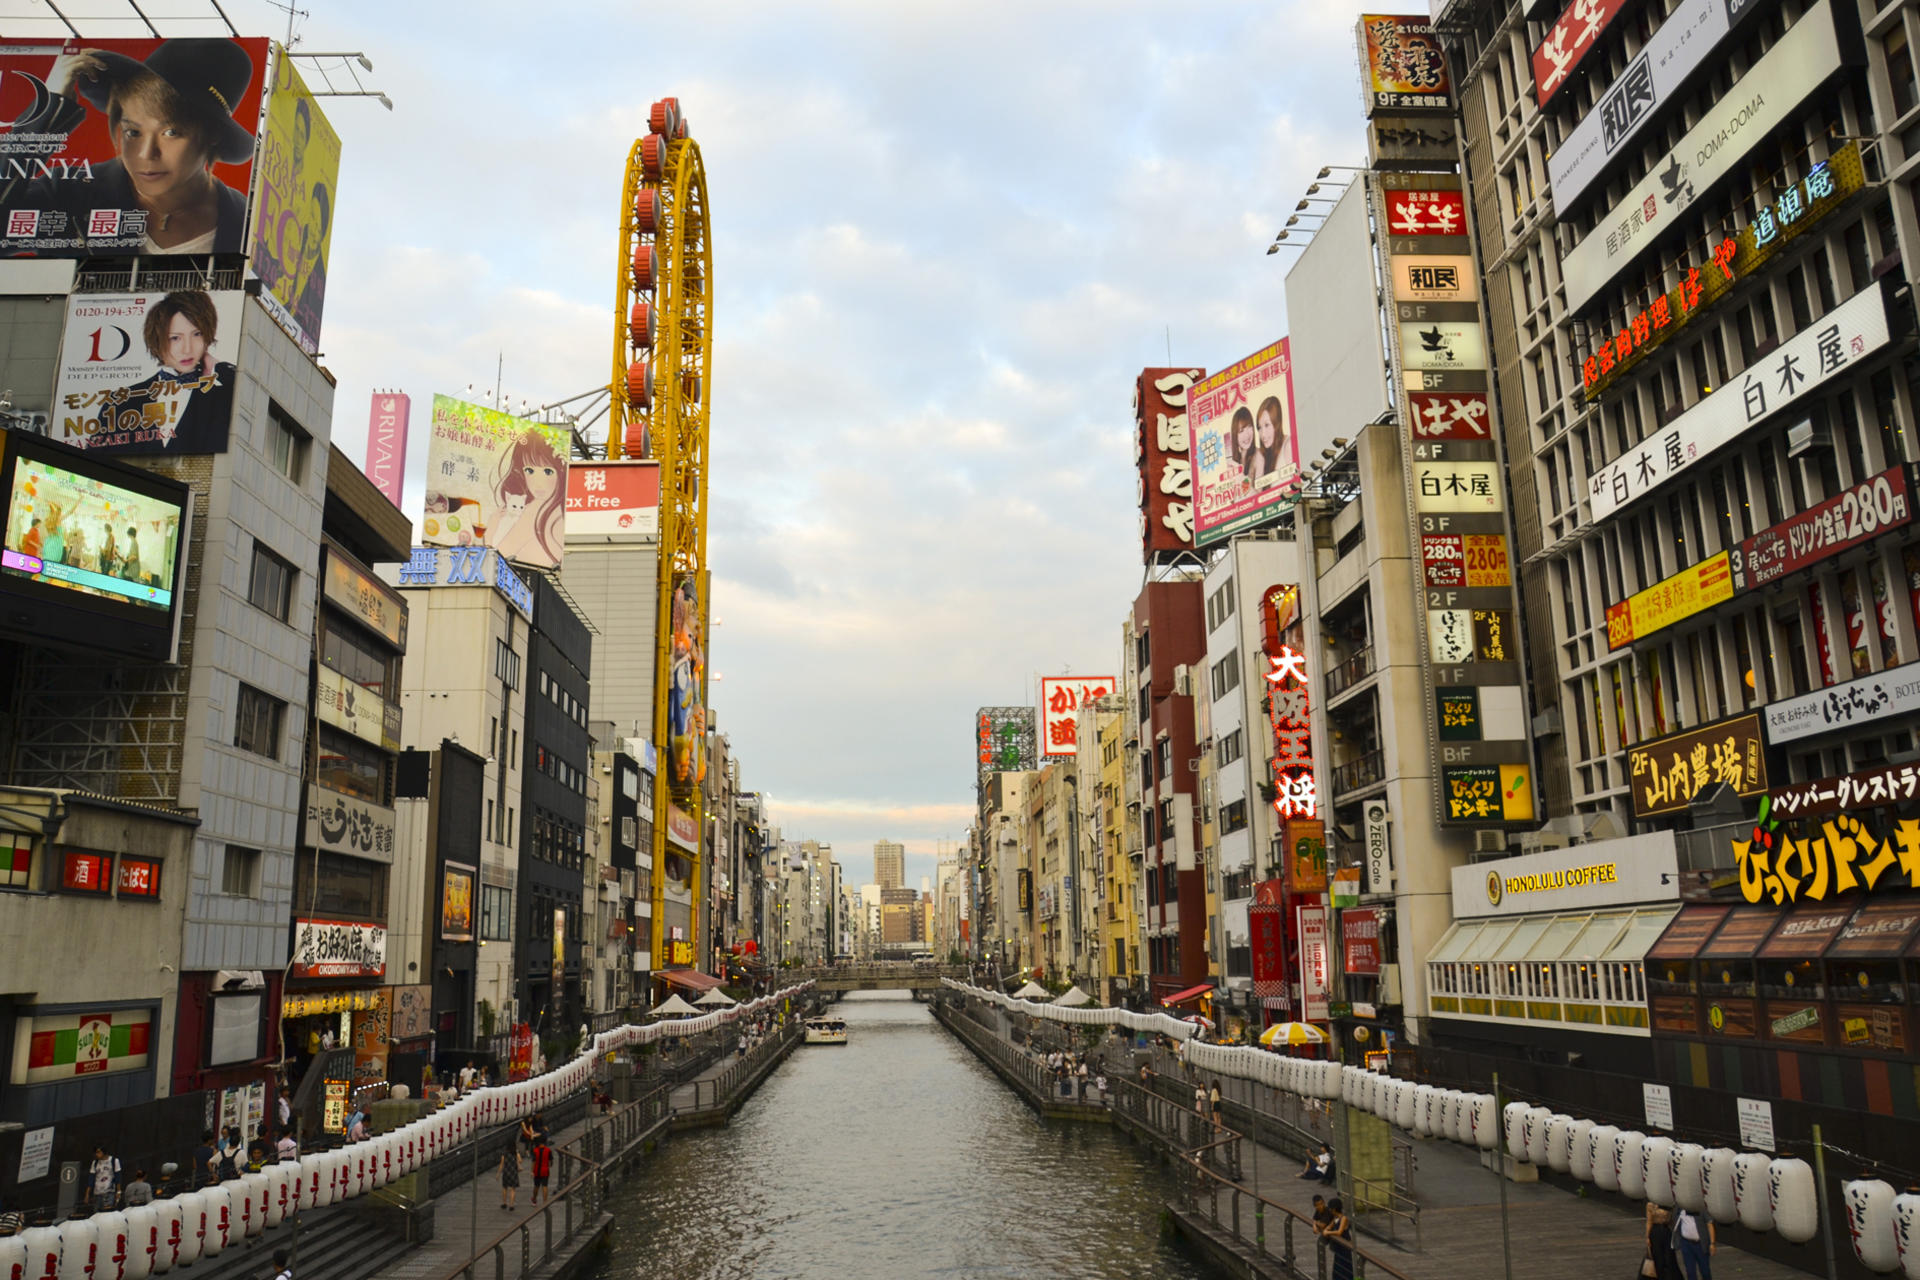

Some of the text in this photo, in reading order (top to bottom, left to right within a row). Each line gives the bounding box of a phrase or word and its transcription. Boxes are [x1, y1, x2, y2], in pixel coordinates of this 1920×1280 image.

[1378, 92, 1398, 106] 9F
[1603, 61, 1653, 146] 和民
[1697, 92, 1765, 168] DOMA-DOMA
[0, 157, 95, 180] NNYA
[1752, 159, 1833, 249] 道頓庵
[87, 208, 150, 237] 最高
[1605, 206, 1645, 259] 居酒家
[1410, 266, 1460, 289] 和民
[75, 306, 145, 318] 0120-194-373
[1401, 306, 1428, 319] 6F
[1424, 375, 1444, 388] 5F
[1743, 323, 1848, 423] 白木屋
[63, 373, 219, 410] モンスターグループ
[1197, 382, 1247, 425] 高収入
[436, 407, 529, 446] 私を本気にさせる
[1411, 398, 1488, 437] はや
[435, 424, 496, 453] お嬢様酵素
[374, 414, 396, 498] RIVALA
[1415, 444, 1443, 459] 4F
[583, 469, 607, 492] 税
[1593, 430, 1686, 506] 4F 白木屋
[1420, 470, 1494, 497] 白木屋
[587, 495, 621, 508] Free
[1423, 517, 1450, 532] 3F
[1788, 475, 1908, 561] ドリンク全品 280円
[1423, 545, 1463, 560] 280円
[1466, 547, 1507, 571] 280円
[1429, 592, 1458, 607] 2F
[1474, 611, 1487, 621] 2F
[1438, 669, 1465, 683] 1F
[1048, 685, 1108, 715] かに
[1444, 701, 1472, 714] びっくり
[1787, 701, 1819, 721] お好み焼
[1822, 683, 1889, 724] ぼてぢゅう
[1264, 646, 1316, 819] 大阪王将
[1443, 714, 1475, 727] ドンキー
[1443, 746, 1471, 763] B1F
[1631, 751, 1649, 777] 2F
[1645, 736, 1743, 809] 山内農場
[1451, 778, 1496, 800] びっくり
[1771, 766, 1920, 814] ハンバーグレストラ
[1449, 798, 1501, 818] ドンキー
[1370, 824, 1383, 885] ZERO cafe
[74, 859, 91, 884] 酒
[118, 865, 150, 889] たばこ
[1505, 862, 1618, 895] HONOLULU COFFEE
[318, 964, 360, 975] OKONOMIYAKI
